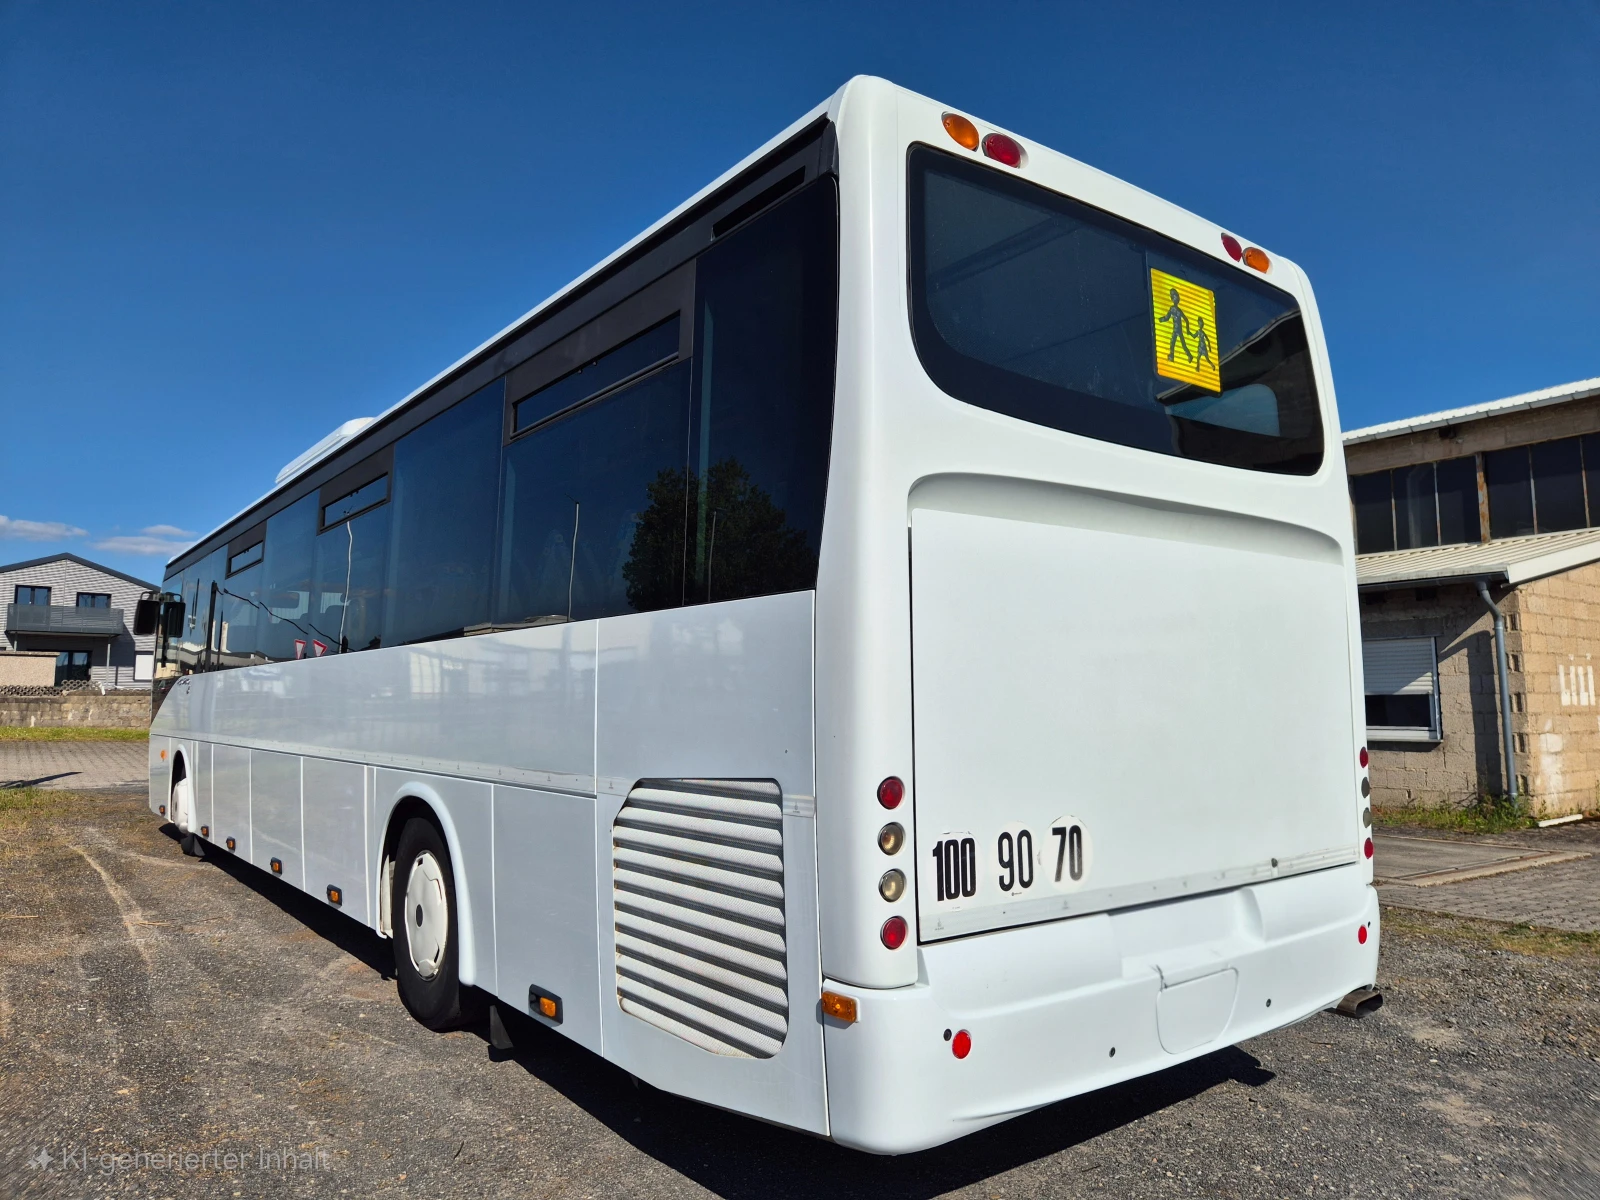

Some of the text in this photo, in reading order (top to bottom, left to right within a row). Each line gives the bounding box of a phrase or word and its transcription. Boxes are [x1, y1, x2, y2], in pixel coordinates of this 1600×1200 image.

[932, 838, 977, 902] 100
[997, 829, 1034, 892] 90
[1052, 825, 1083, 883] 70
